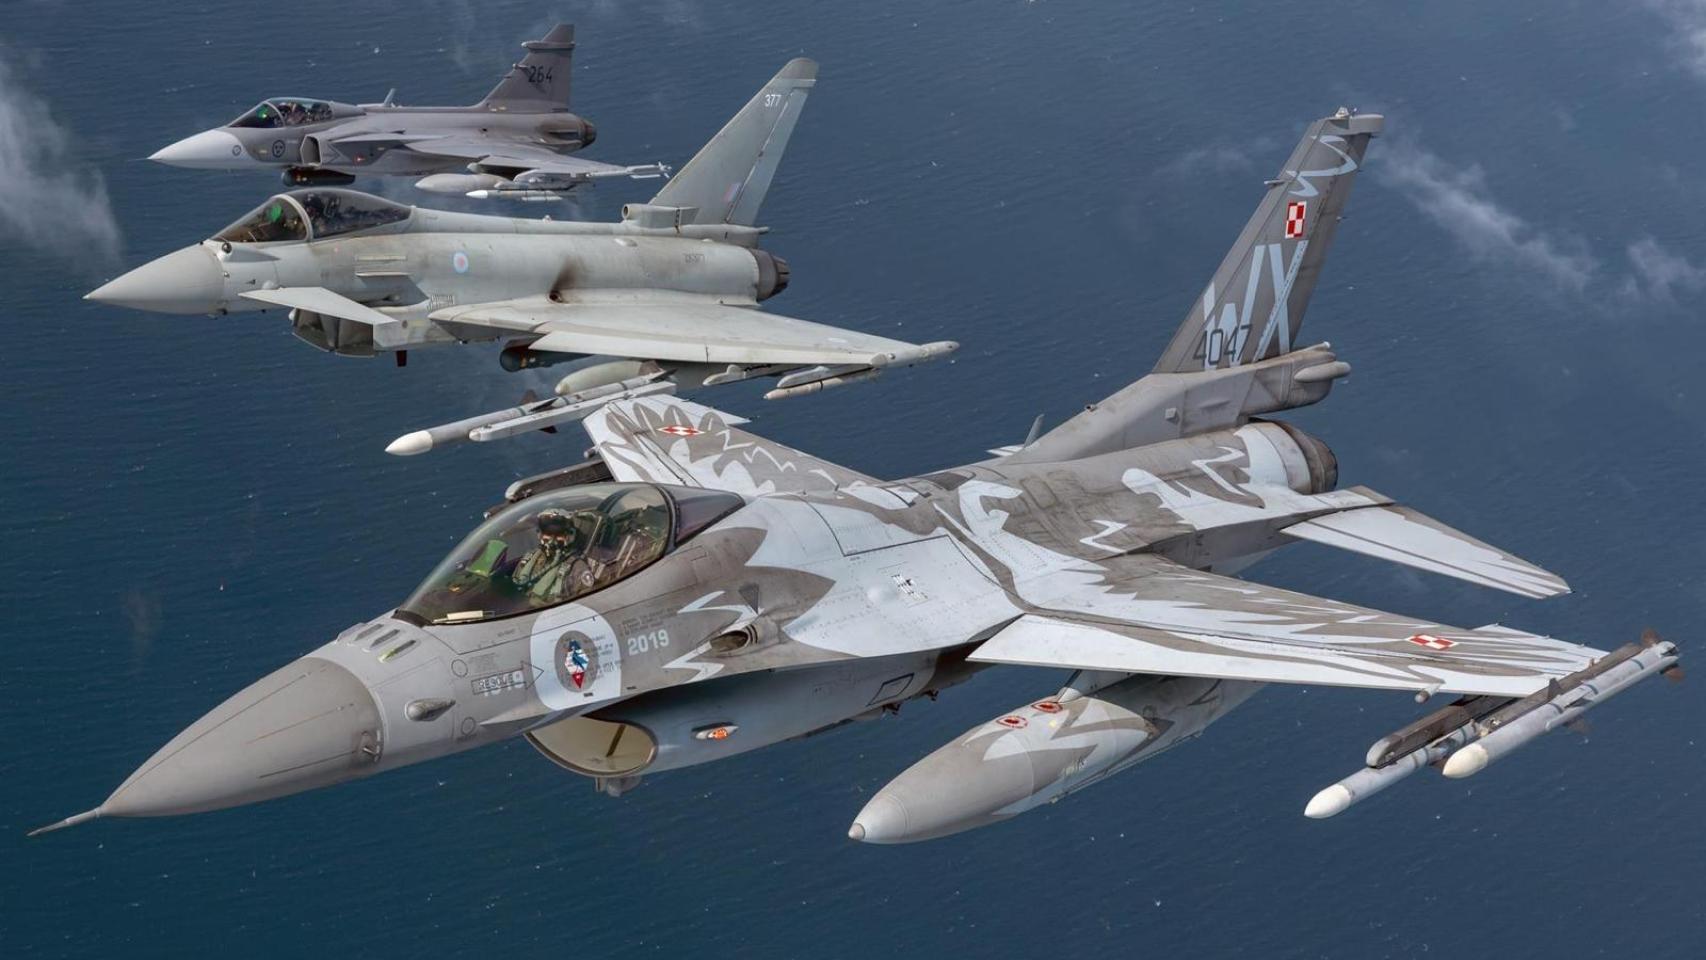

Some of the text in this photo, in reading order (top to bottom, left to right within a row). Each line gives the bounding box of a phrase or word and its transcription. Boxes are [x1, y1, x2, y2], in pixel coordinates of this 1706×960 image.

[528, 65, 553, 83] 264
[765, 94, 782, 107] 377
[1193, 323, 1253, 366] 4047
[627, 629, 669, 656] 2019
[479, 673, 514, 691] RESCUE
